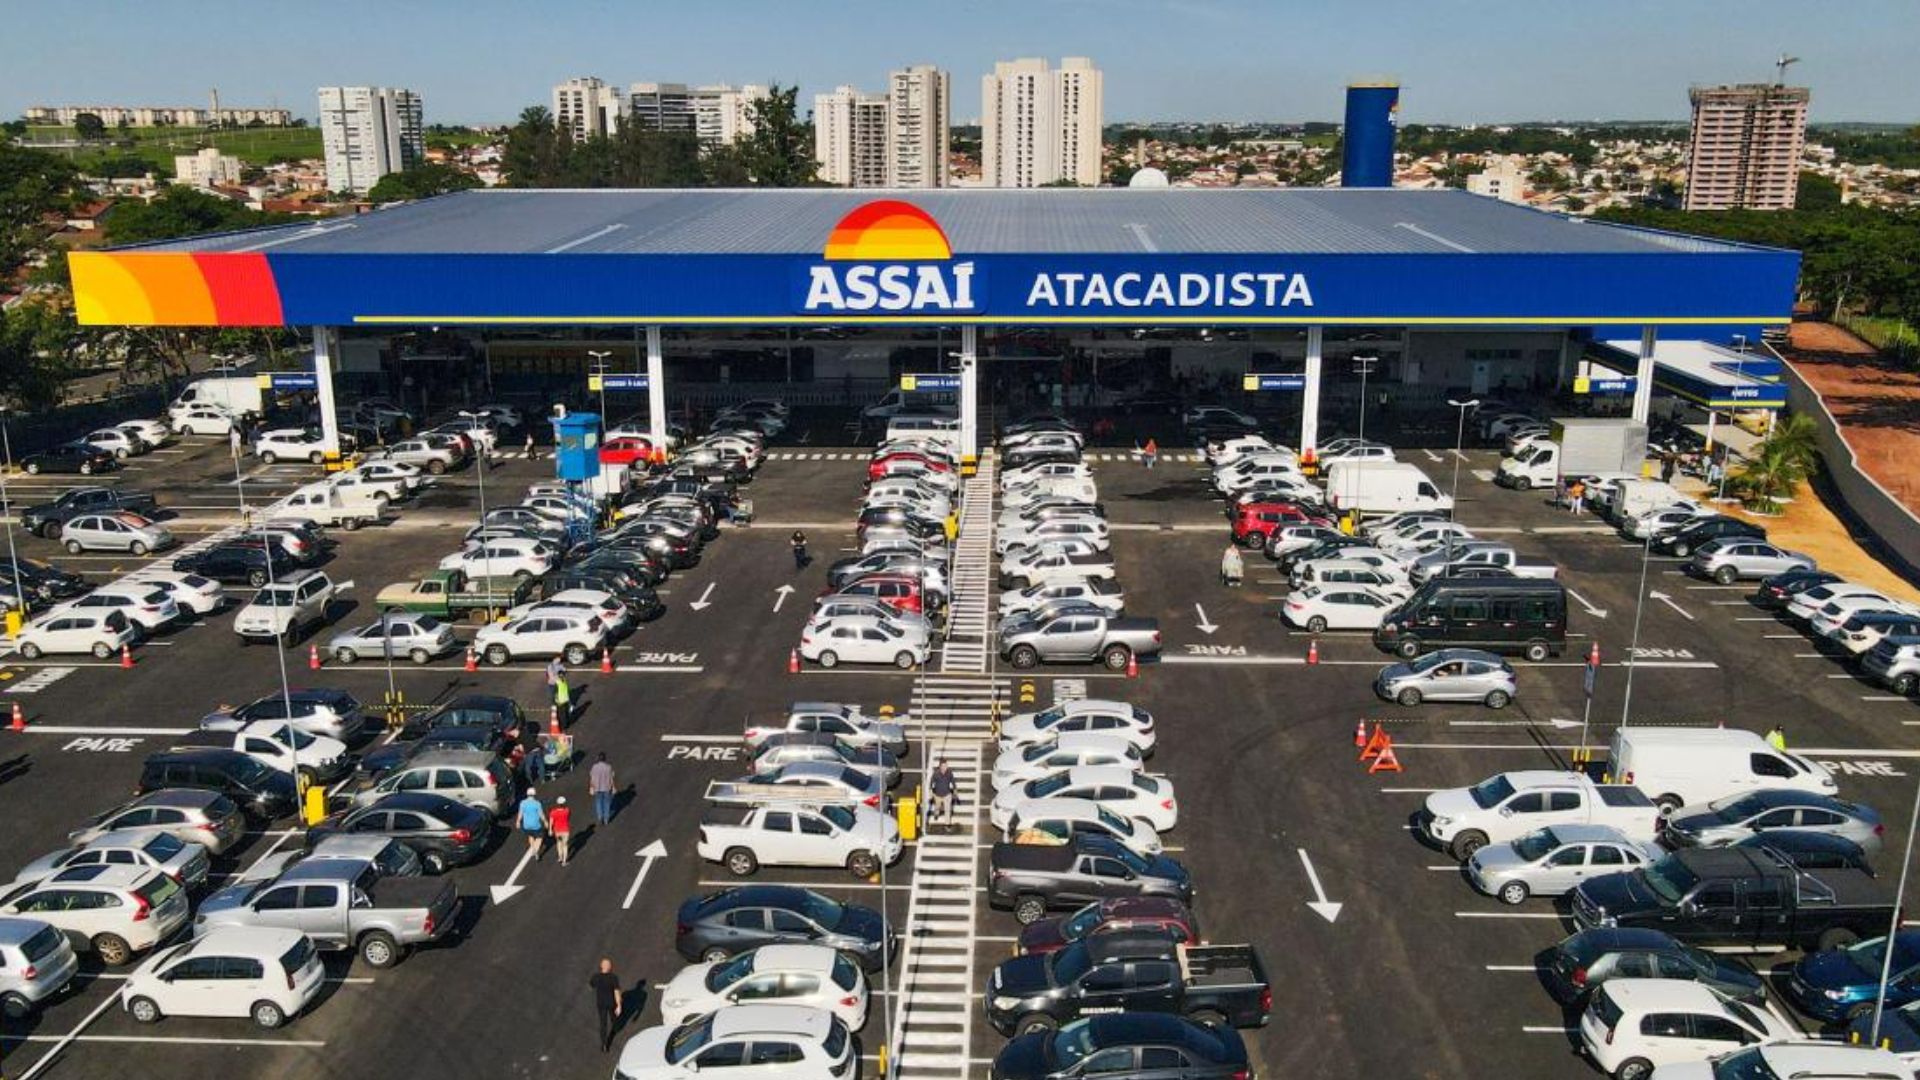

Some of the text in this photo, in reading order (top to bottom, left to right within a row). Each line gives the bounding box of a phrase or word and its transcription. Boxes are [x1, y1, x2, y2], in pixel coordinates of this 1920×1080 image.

[805, 262, 1314, 310] ASSAÍ ATACADISTA
[635, 652, 699, 663] PARE
[1184, 644, 1247, 656] PARE
[1624, 647, 1696, 659] PARE
[61, 737, 145, 752] PARE
[667, 745, 741, 760] PARE
[1816, 761, 1907, 776] PARE
